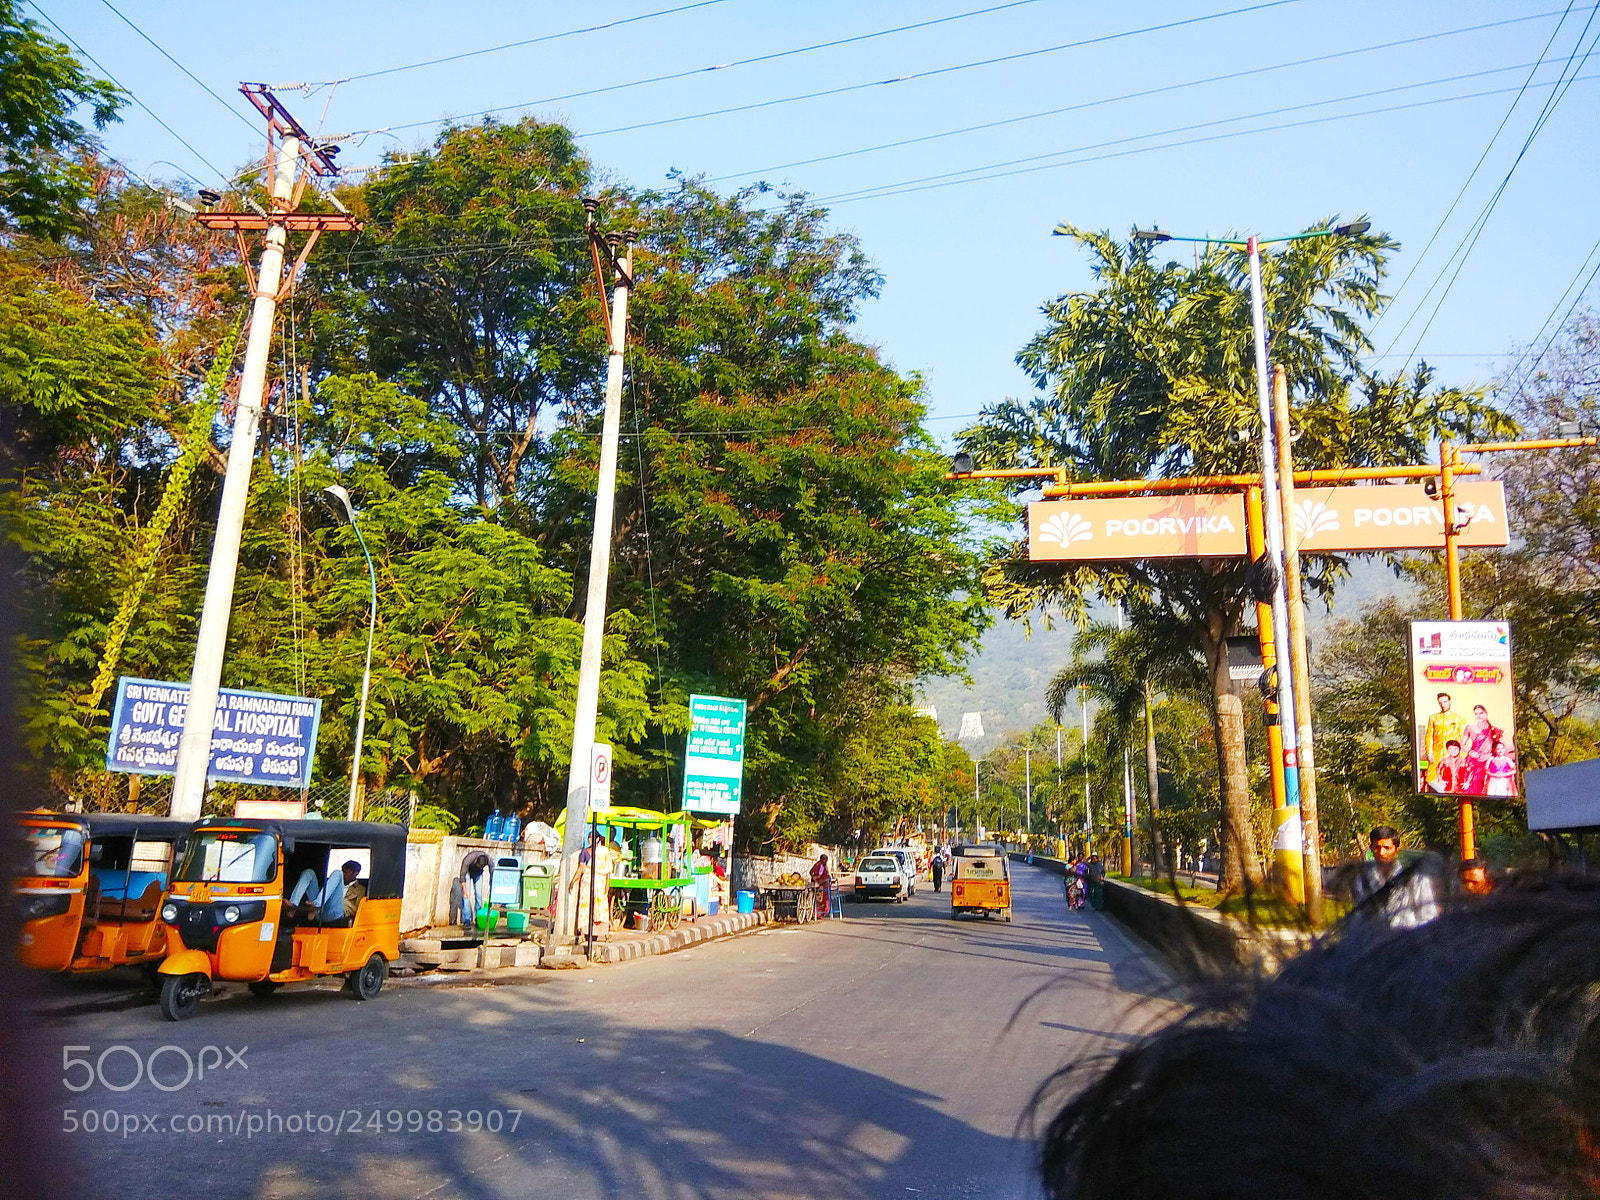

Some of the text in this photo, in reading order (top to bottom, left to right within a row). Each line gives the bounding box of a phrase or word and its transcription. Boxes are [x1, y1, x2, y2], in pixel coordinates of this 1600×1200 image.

[1105, 515, 1235, 537] POORVIKA
[126, 684, 142, 699] SRI
[229, 695, 291, 715] RAMNARAIN
[168, 705, 233, 732] GEAL
[234, 711, 303, 738] HOSPITAL
